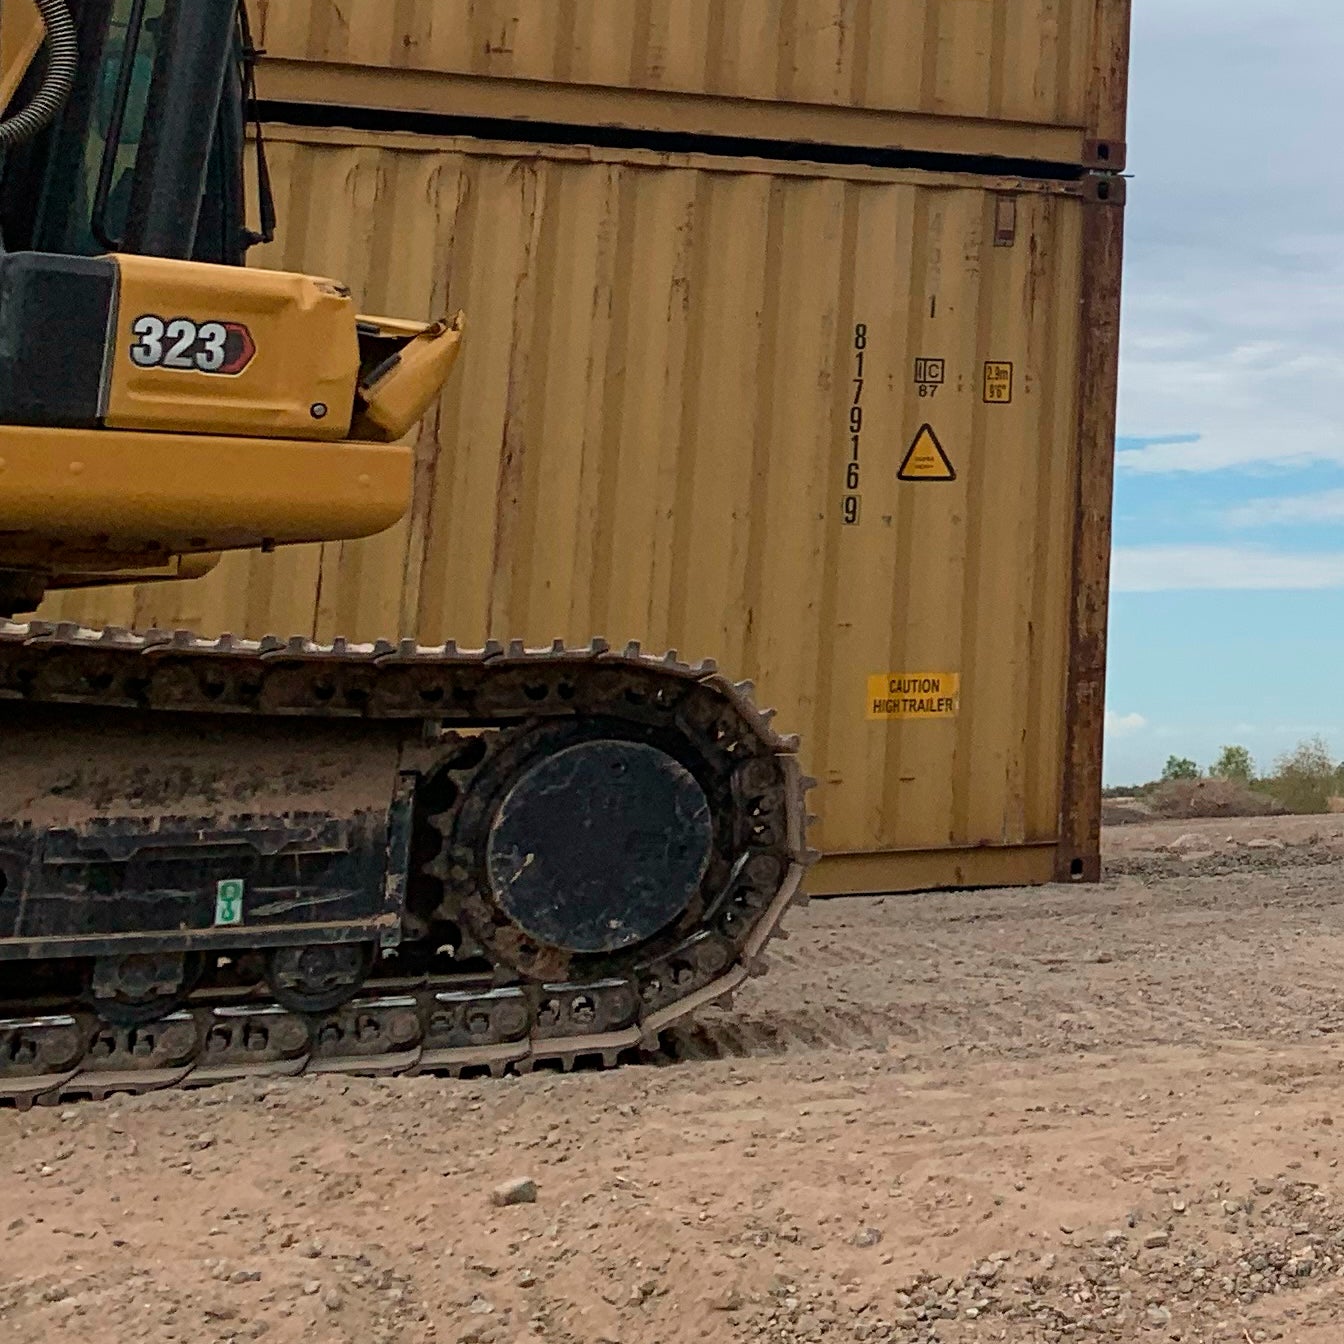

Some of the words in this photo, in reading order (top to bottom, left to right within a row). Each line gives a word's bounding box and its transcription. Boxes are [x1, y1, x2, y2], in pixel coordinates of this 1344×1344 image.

[132, 316, 227, 370] 323
[918, 385, 938, 397] 87
[889, 678, 940, 694] CAUTION
[873, 699, 900, 714] HIGH
[901, 697, 953, 713] TRAILER
